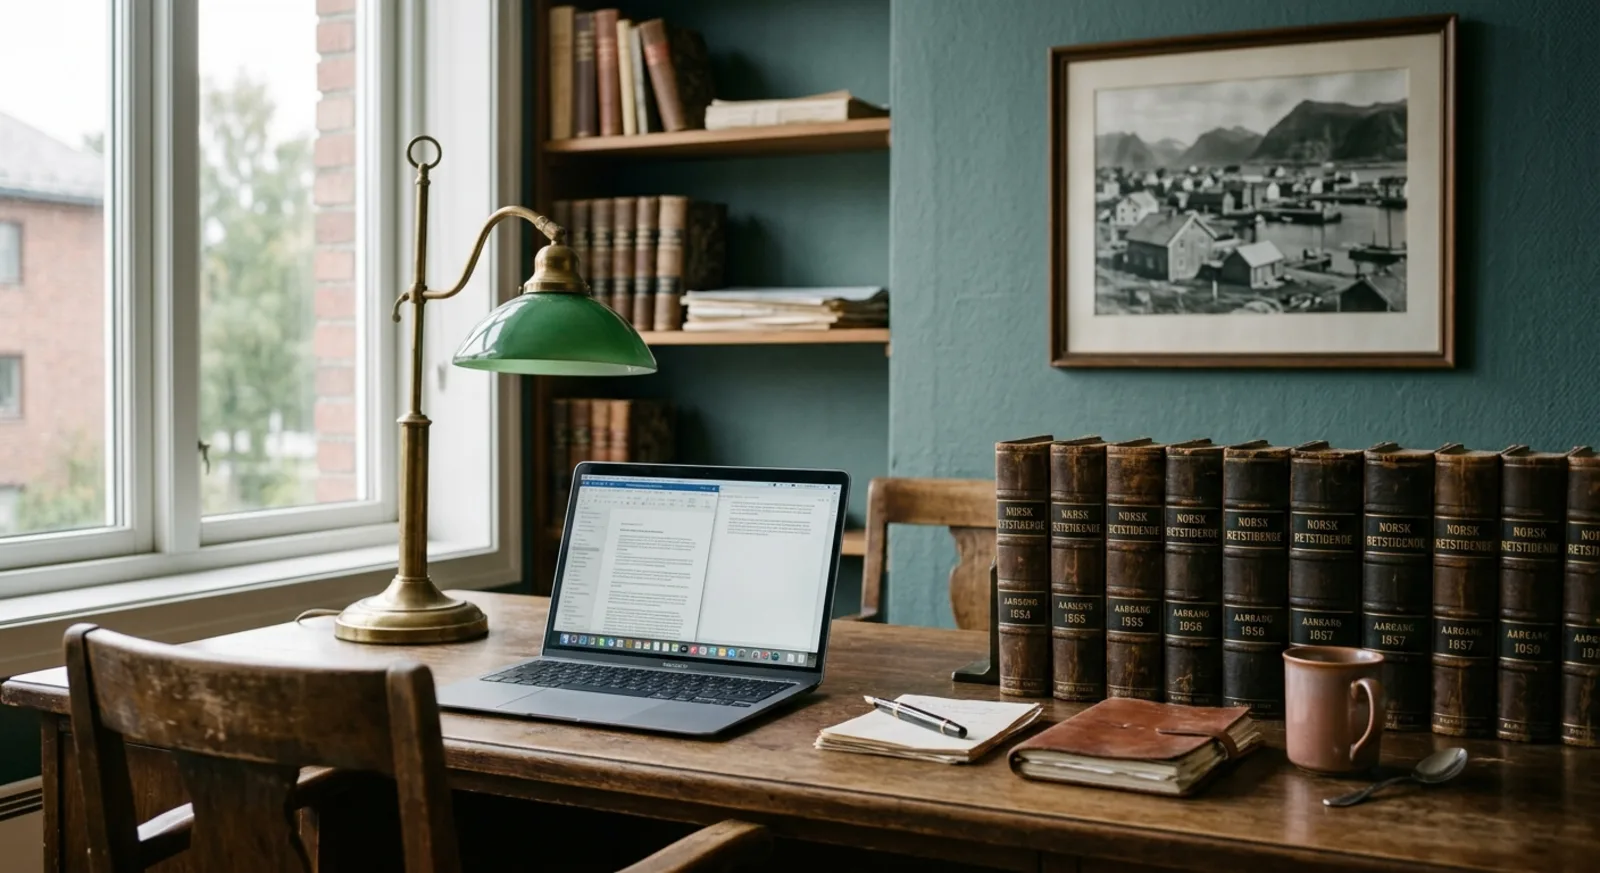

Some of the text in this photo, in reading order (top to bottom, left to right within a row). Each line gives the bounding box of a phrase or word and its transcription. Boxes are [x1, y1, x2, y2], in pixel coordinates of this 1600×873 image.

[1177, 514, 1206, 524] NORSK
[1308, 520, 1338, 530] NORSK
[1380, 522, 1412, 534] NORSK
[1447, 524, 1480, 536] NORSK
[1513, 526, 1547, 538] NORSK
